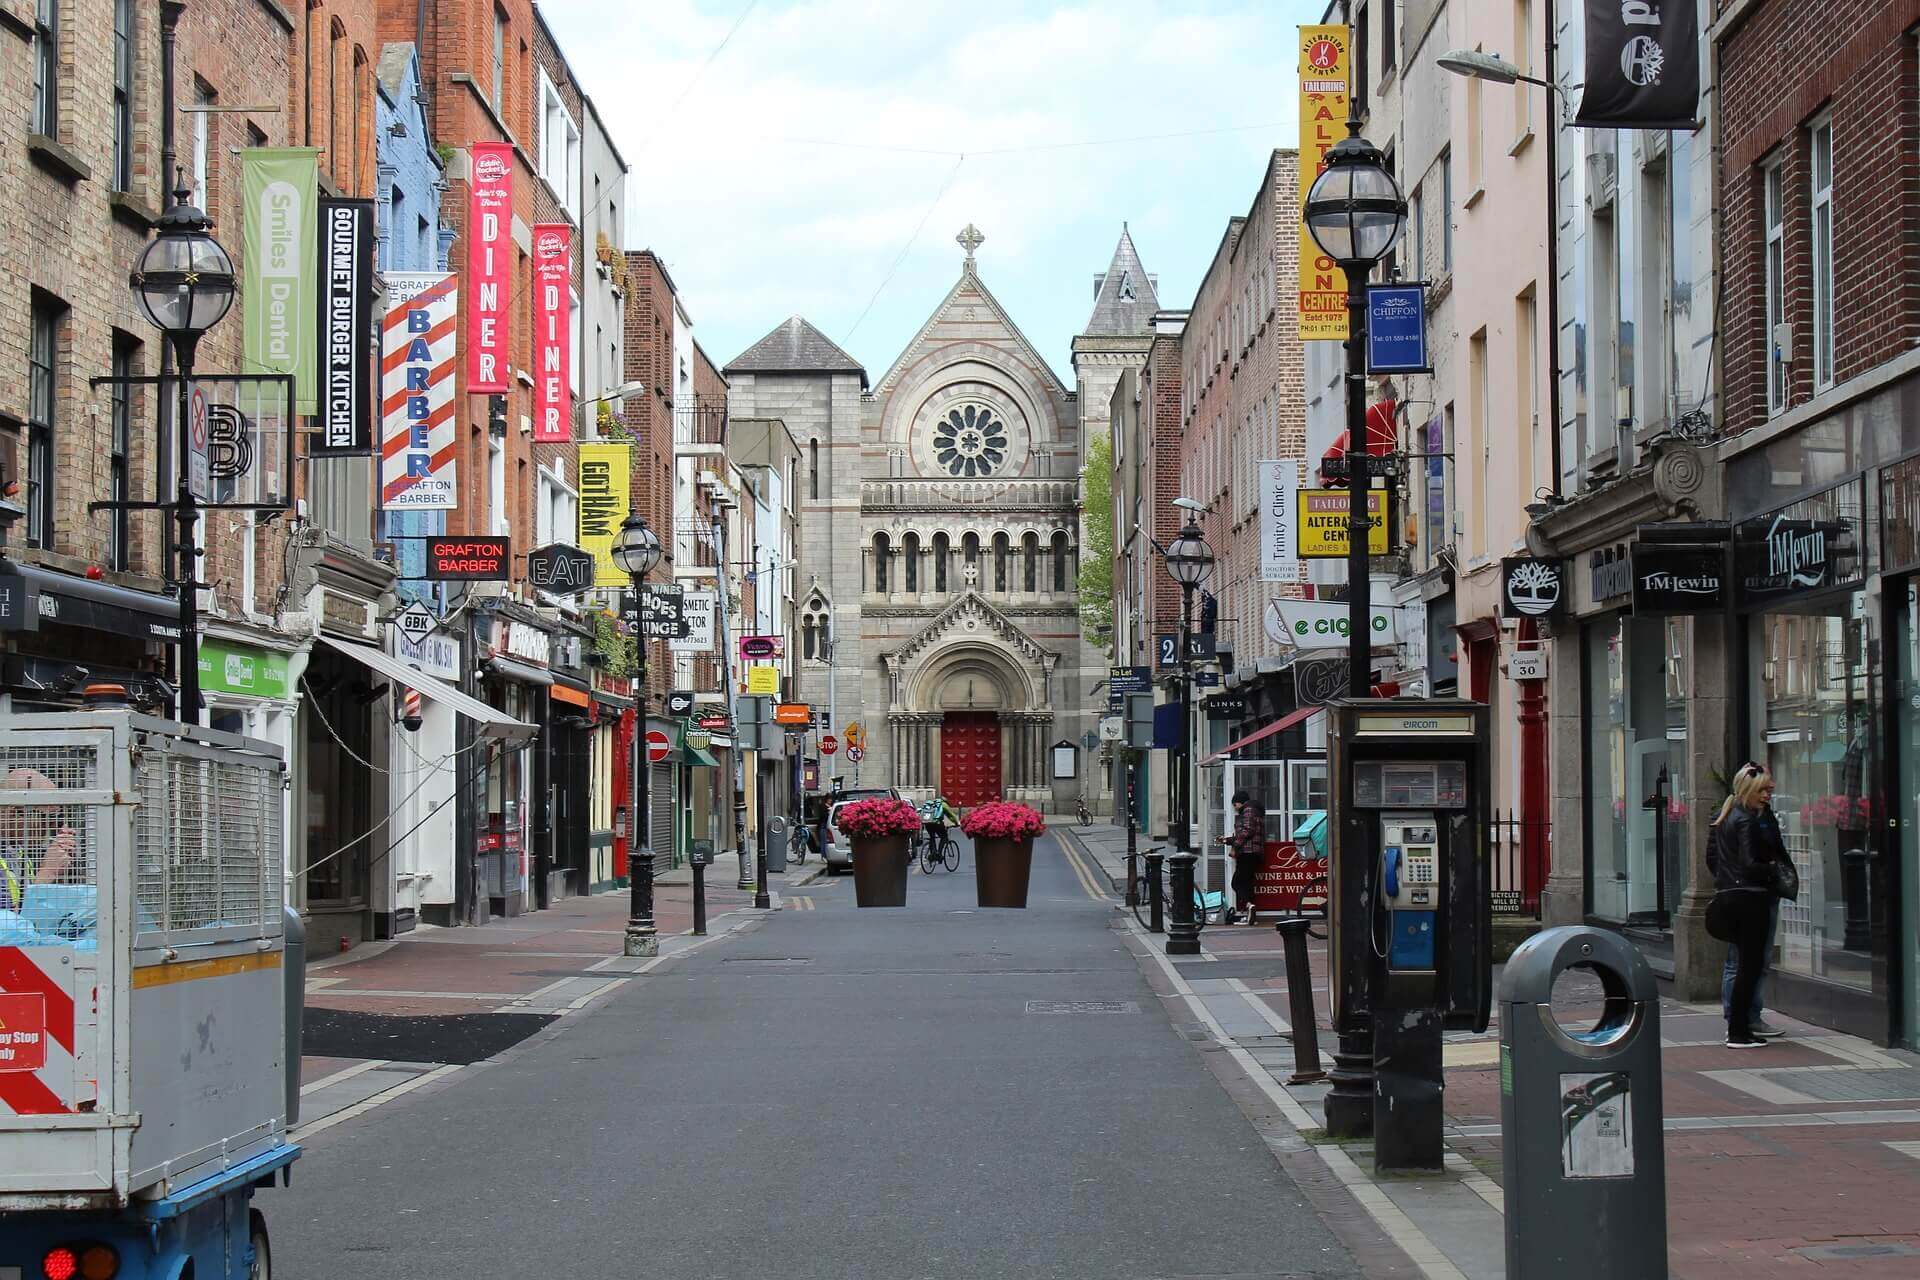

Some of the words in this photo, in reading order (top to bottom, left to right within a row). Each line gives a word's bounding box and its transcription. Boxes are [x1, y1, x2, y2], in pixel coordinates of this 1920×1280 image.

[1304, 81, 1345, 92] TAILORING
[269, 194, 291, 269] Smiles
[334, 208, 353, 294] GOURMET
[478, 213, 499, 384] DINER
[1303, 293, 1345, 310] CENTRE
[1373, 307, 1417, 316] CHIFFON
[268, 281, 292, 363] Dental
[332, 299, 354, 369] BURGER
[544, 286, 560, 434] DINER
[407, 310, 432, 478] BARBER
[331, 373, 352, 447] KITCHEN
[400, 495, 446, 503] BARBER
[582, 462, 620, 536] GOTHAM
[1273, 485, 1285, 518] Clinic
[1273, 522, 1287, 560] Trinity
[434, 544, 503, 557] GRAFTON
[438, 560, 498, 572] BARBER
[531, 554, 588, 585] EAT
[651, 585, 682, 594] WINES
[405, 616, 428, 629] GBK
[1519, 666, 1536, 675] 30
[820, 741, 838, 750] STOP
[1255, 872, 1282, 881] WINE
[1284, 872, 1304, 880] BAR
[1254, 886, 1285, 894] LDEST
[13, 1031, 39, 1044] Stop
